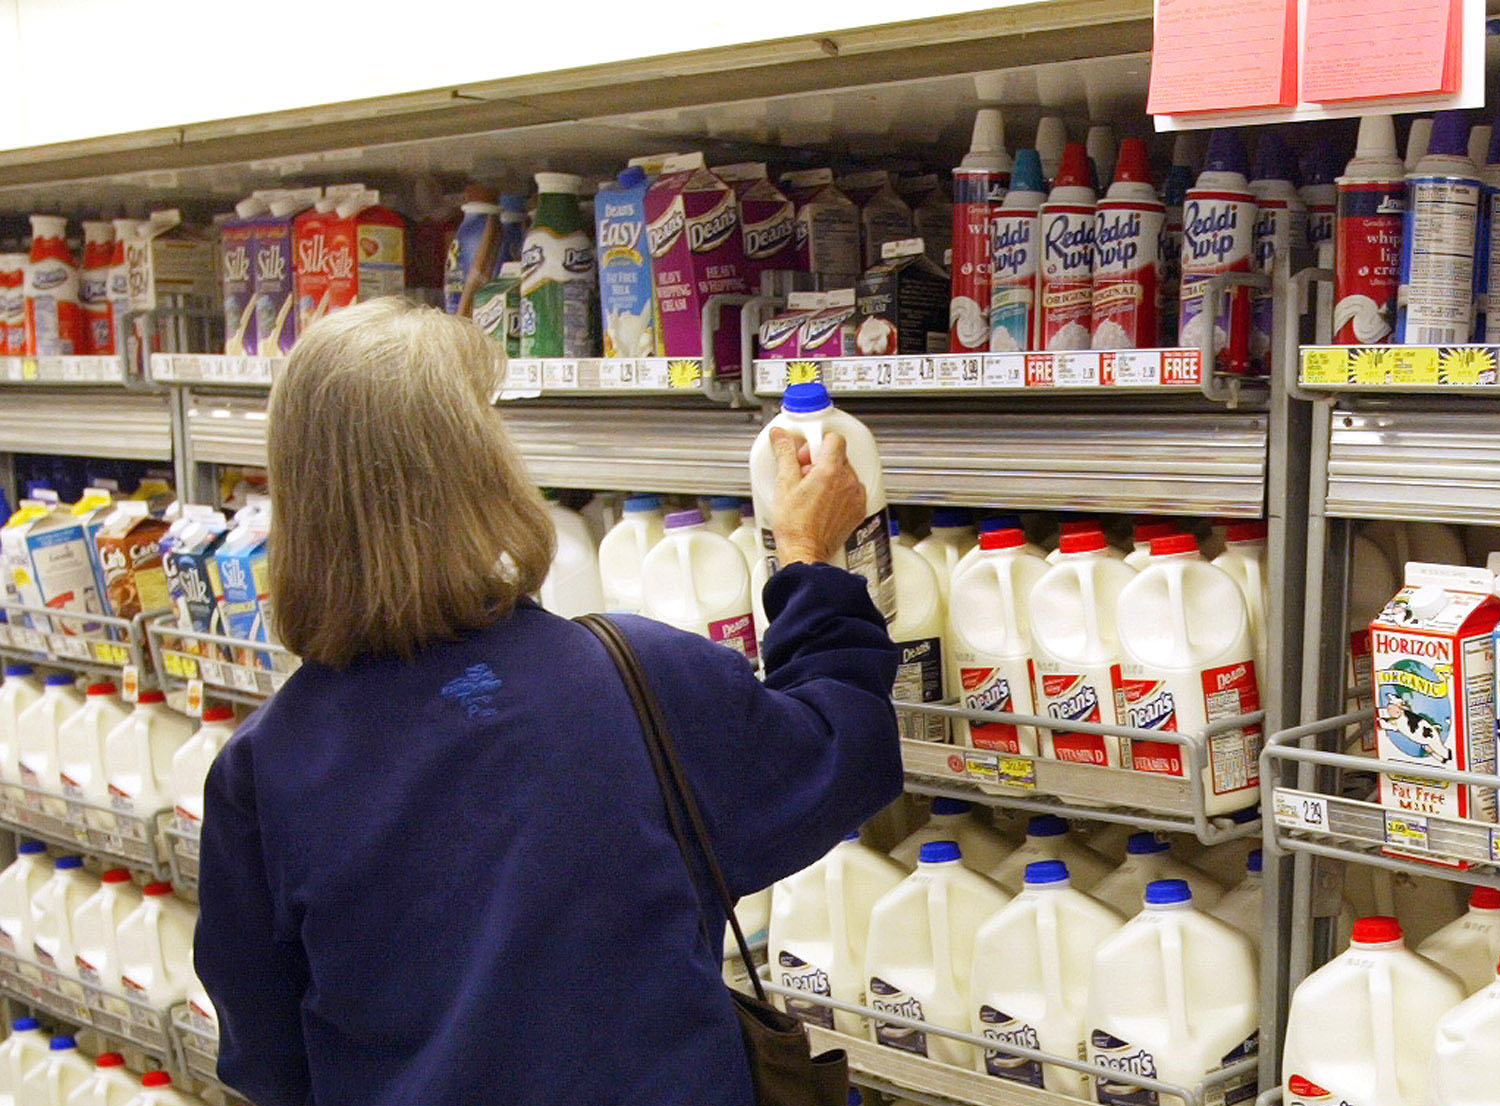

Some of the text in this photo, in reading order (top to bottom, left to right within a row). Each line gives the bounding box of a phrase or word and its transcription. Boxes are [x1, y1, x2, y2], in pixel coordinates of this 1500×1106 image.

[600, 217, 641, 251] Easy
[691, 206, 737, 252] Dean's
[745, 216, 795, 259] Dean's
[1185, 204, 1238, 240] Reddi
[258, 244, 284, 280] Silk
[299, 238, 328, 276] Silk
[329, 247, 357, 280] Silk
[1195, 233, 1234, 263] wip
[224, 249, 250, 282] Silk
[1163, 358, 1199, 379] FREE
[1375, 634, 1450, 660] HORIZON
[1218, 660, 1247, 690] Dean's
[1382, 672, 1440, 695] ORGANIC
[967, 677, 1010, 711] Dean's
[1048, 684, 1098, 721] Dean's
[1128, 690, 1175, 731] Dean's
[1391, 782, 1445, 804] Fat Free
[983, 1026, 1038, 1050] Dean's
[1094, 1051, 1155, 1080] Dean's
